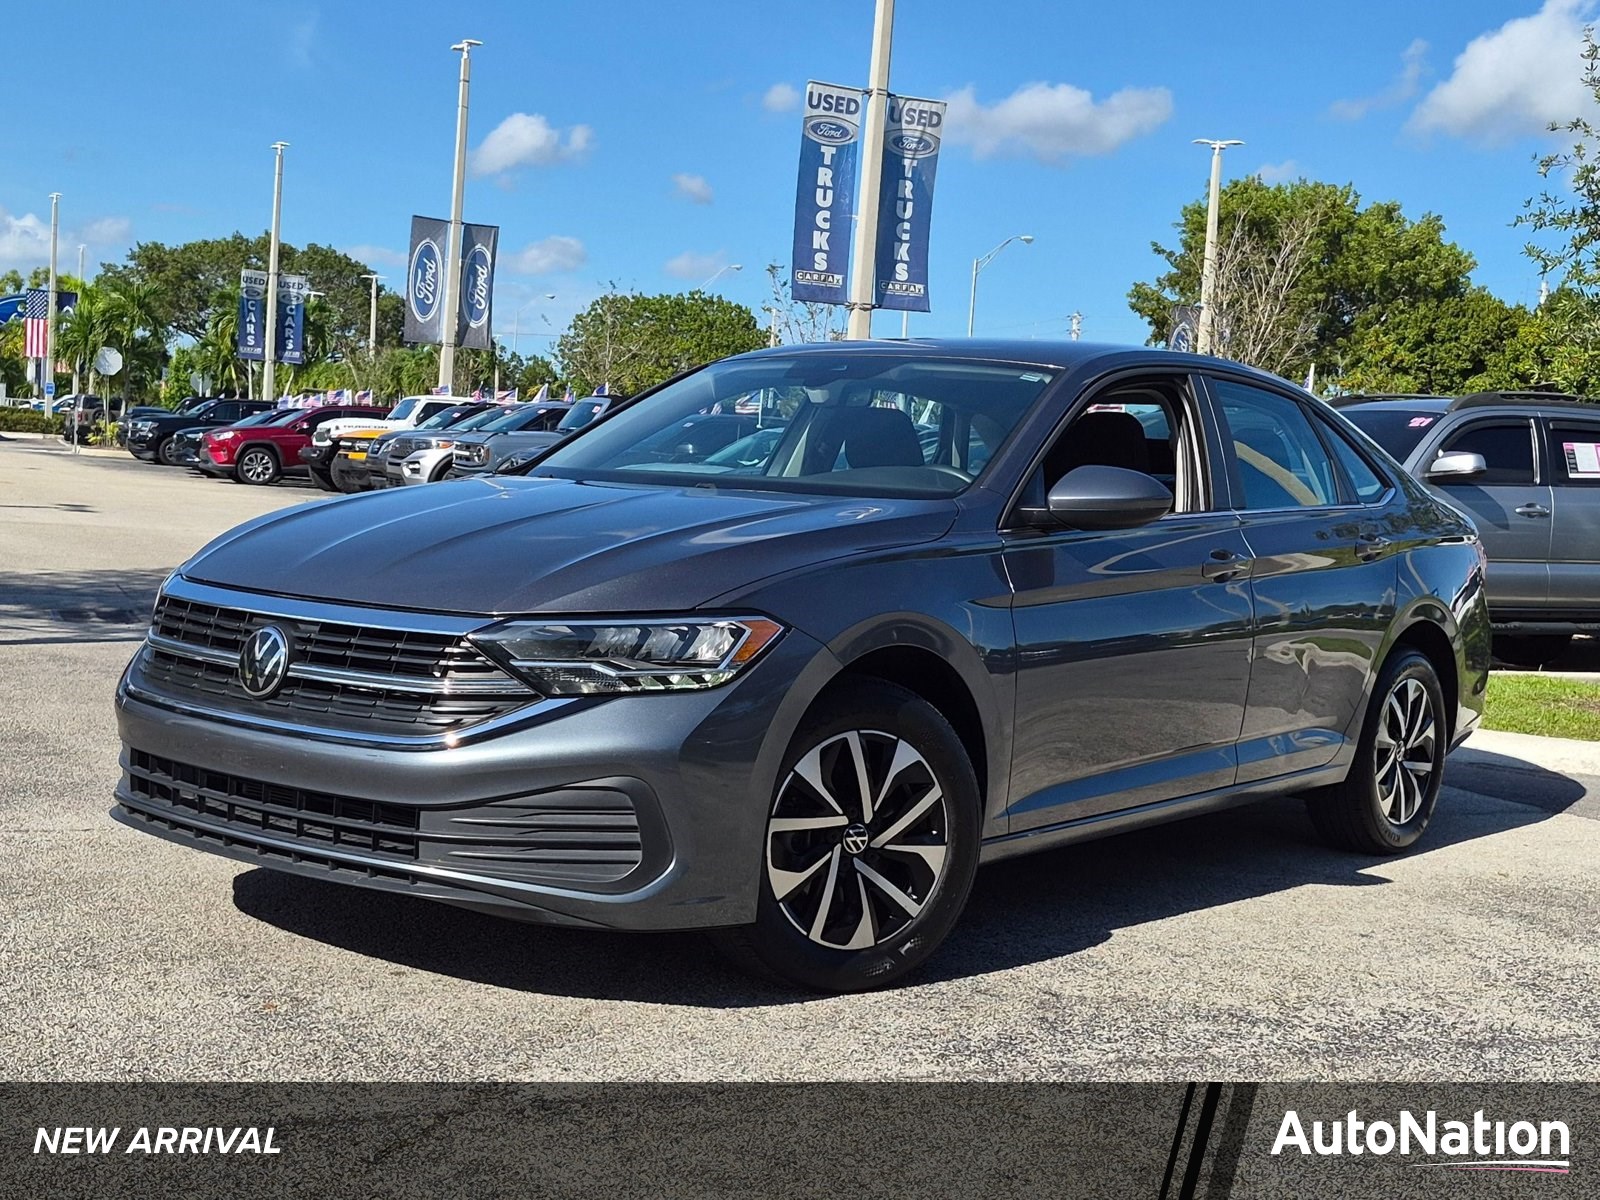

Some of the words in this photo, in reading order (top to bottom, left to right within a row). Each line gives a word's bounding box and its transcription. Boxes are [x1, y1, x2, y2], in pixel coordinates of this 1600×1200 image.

[808, 90, 860, 115] USED
[889, 102, 942, 128] USED
[816, 123, 842, 138] Ford
[898, 137, 924, 150] Ford
[812, 145, 836, 272] TRUCKS
[895, 158, 917, 282] TRUCKS
[242, 276, 265, 286] USED
[279, 281, 303, 290] USED
[415, 257, 436, 304] Ford
[468, 264, 488, 309] Ford
[796, 271, 842, 285] CARFAX
[880, 281, 925, 294] CARFAX
[246, 300, 256, 346] CARS
[284, 305, 295, 350] CARS
